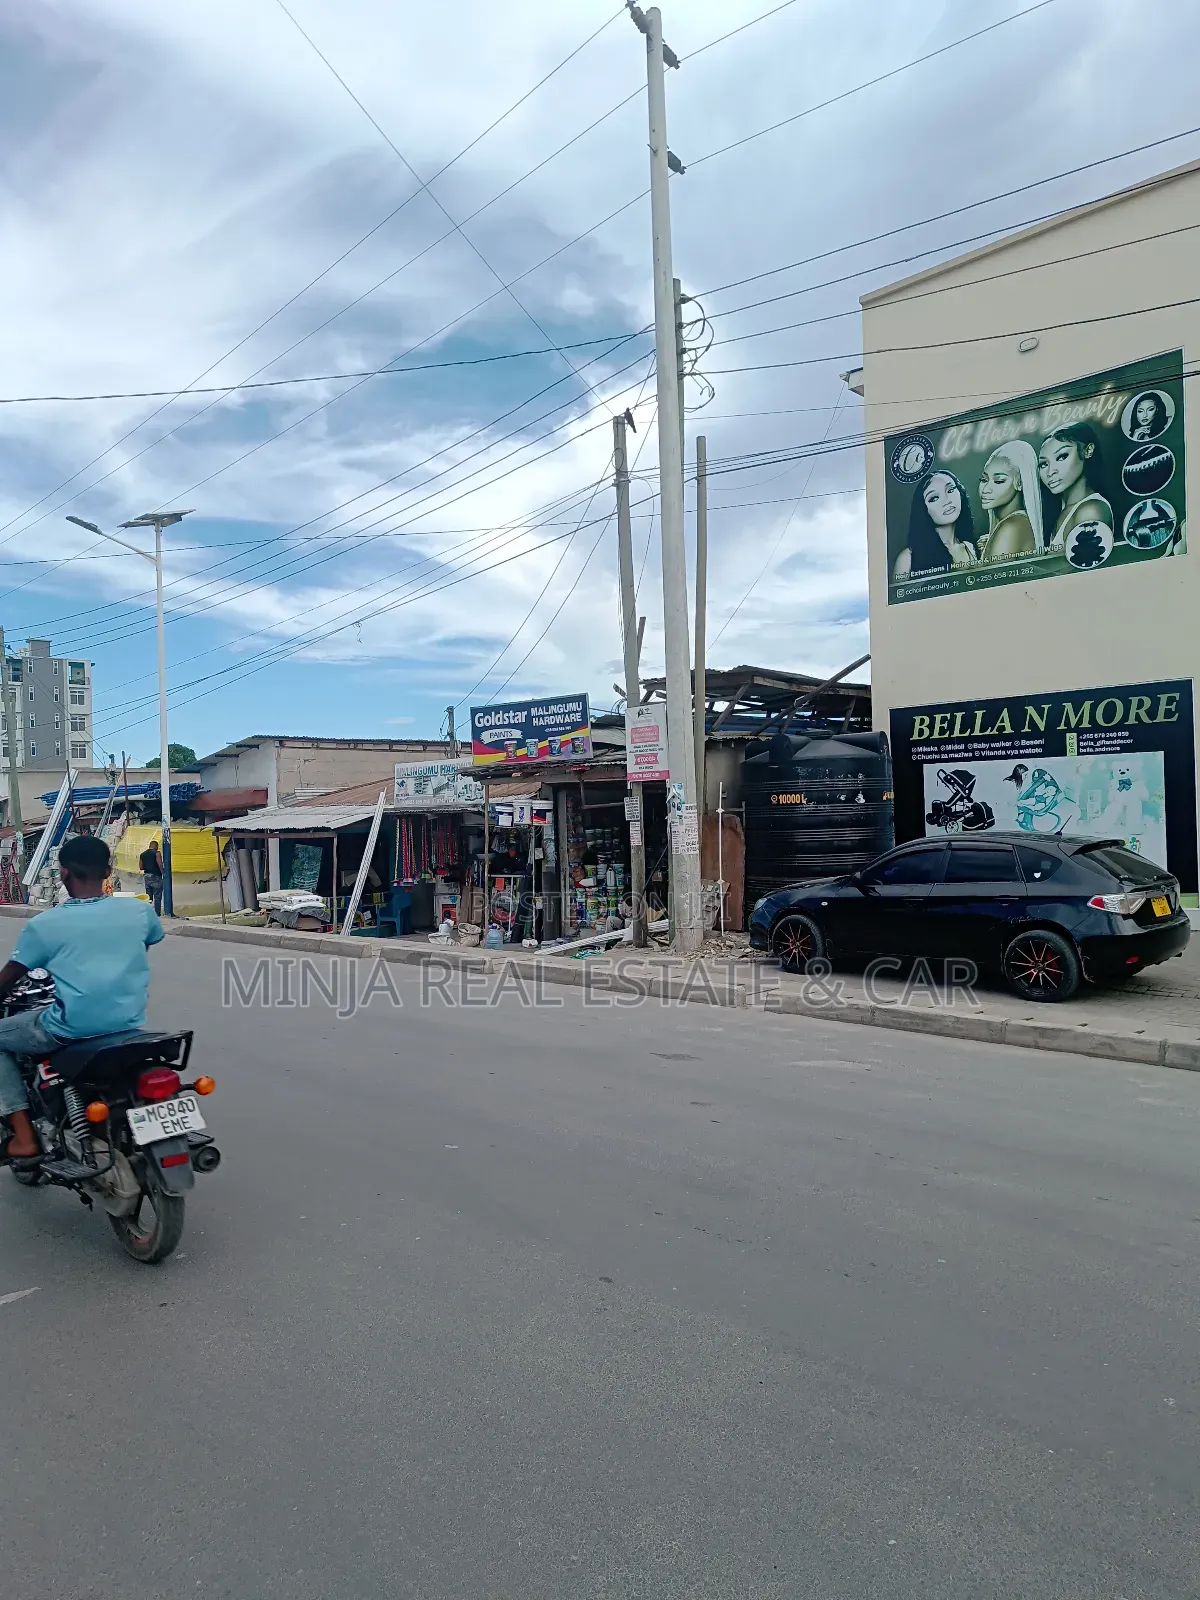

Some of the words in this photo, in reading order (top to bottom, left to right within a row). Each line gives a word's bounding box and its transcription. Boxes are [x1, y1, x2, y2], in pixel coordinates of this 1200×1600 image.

[974, 419, 1021, 449] Hair
[1040, 385, 1128, 432] Beauty
[895, 571, 909, 581] Hair
[911, 565, 945, 578] Extensions
[950, 560, 966, 570] Hair
[991, 548, 1037, 563] Maintenance
[1044, 543, 1064, 555] Wigs
[1008, 569, 1020, 578] 211
[531, 702, 583, 717] MALINGUMU
[910, 707, 1014, 740] BELLA
[1021, 703, 1052, 733] N
[1057, 692, 1181, 730] MORE
[474, 710, 527, 728] Goldstar
[532, 712, 583, 727] HARDWARE
[489, 730, 513, 740] PAINTS
[973, 742, 989, 751] Baby
[991, 740, 1012, 748] walker
[779, 793, 801, 805] 10000
[161, 1116, 192, 1135] EME
